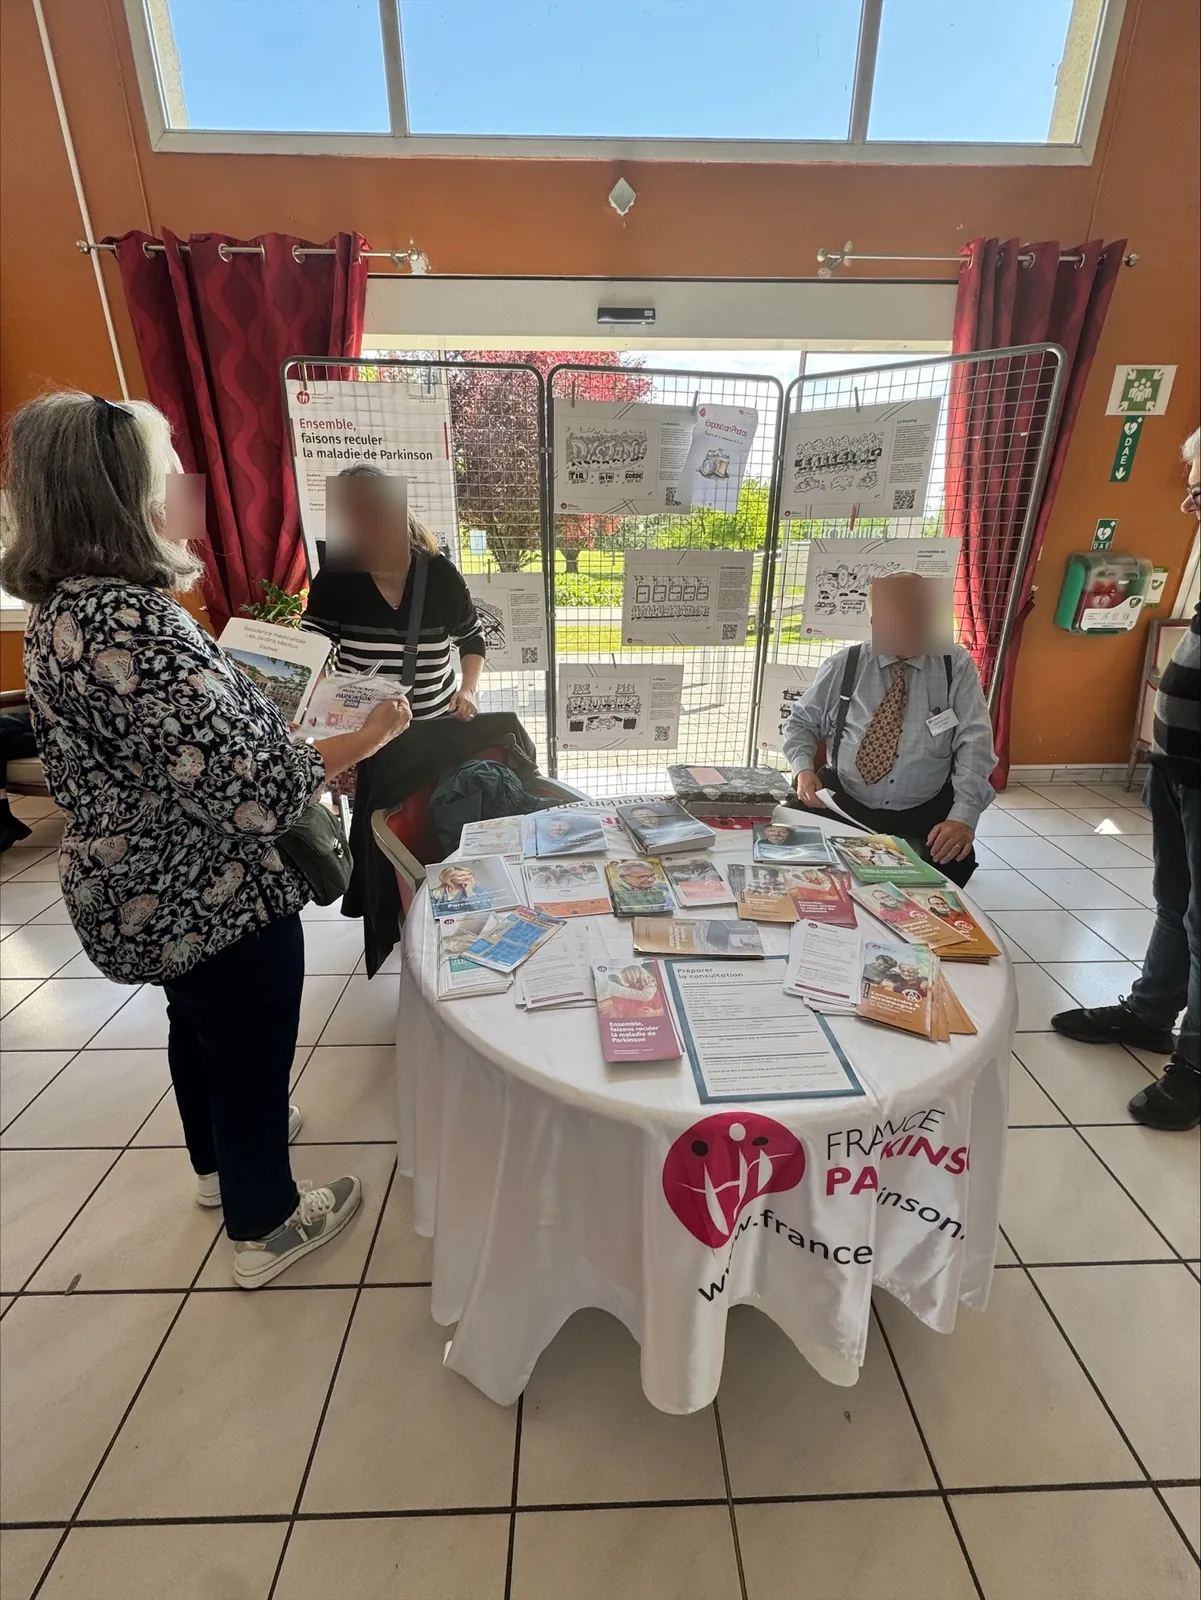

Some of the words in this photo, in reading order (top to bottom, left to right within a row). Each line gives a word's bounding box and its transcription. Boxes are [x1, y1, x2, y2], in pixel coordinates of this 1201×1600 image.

[299, 418, 357, 432] Ensemble,
[301, 432, 342, 445] faisons
[344, 434, 383, 446] reculer
[302, 447, 314, 458] la
[316, 448, 361, 460] maladie
[363, 450, 377, 460] de
[380, 449, 433, 461] Parkinson
[1120, 437, 1132, 465] DAE
[1093, 542, 1109, 550] DAE
[826, 1108, 946, 1161] FRANCE
